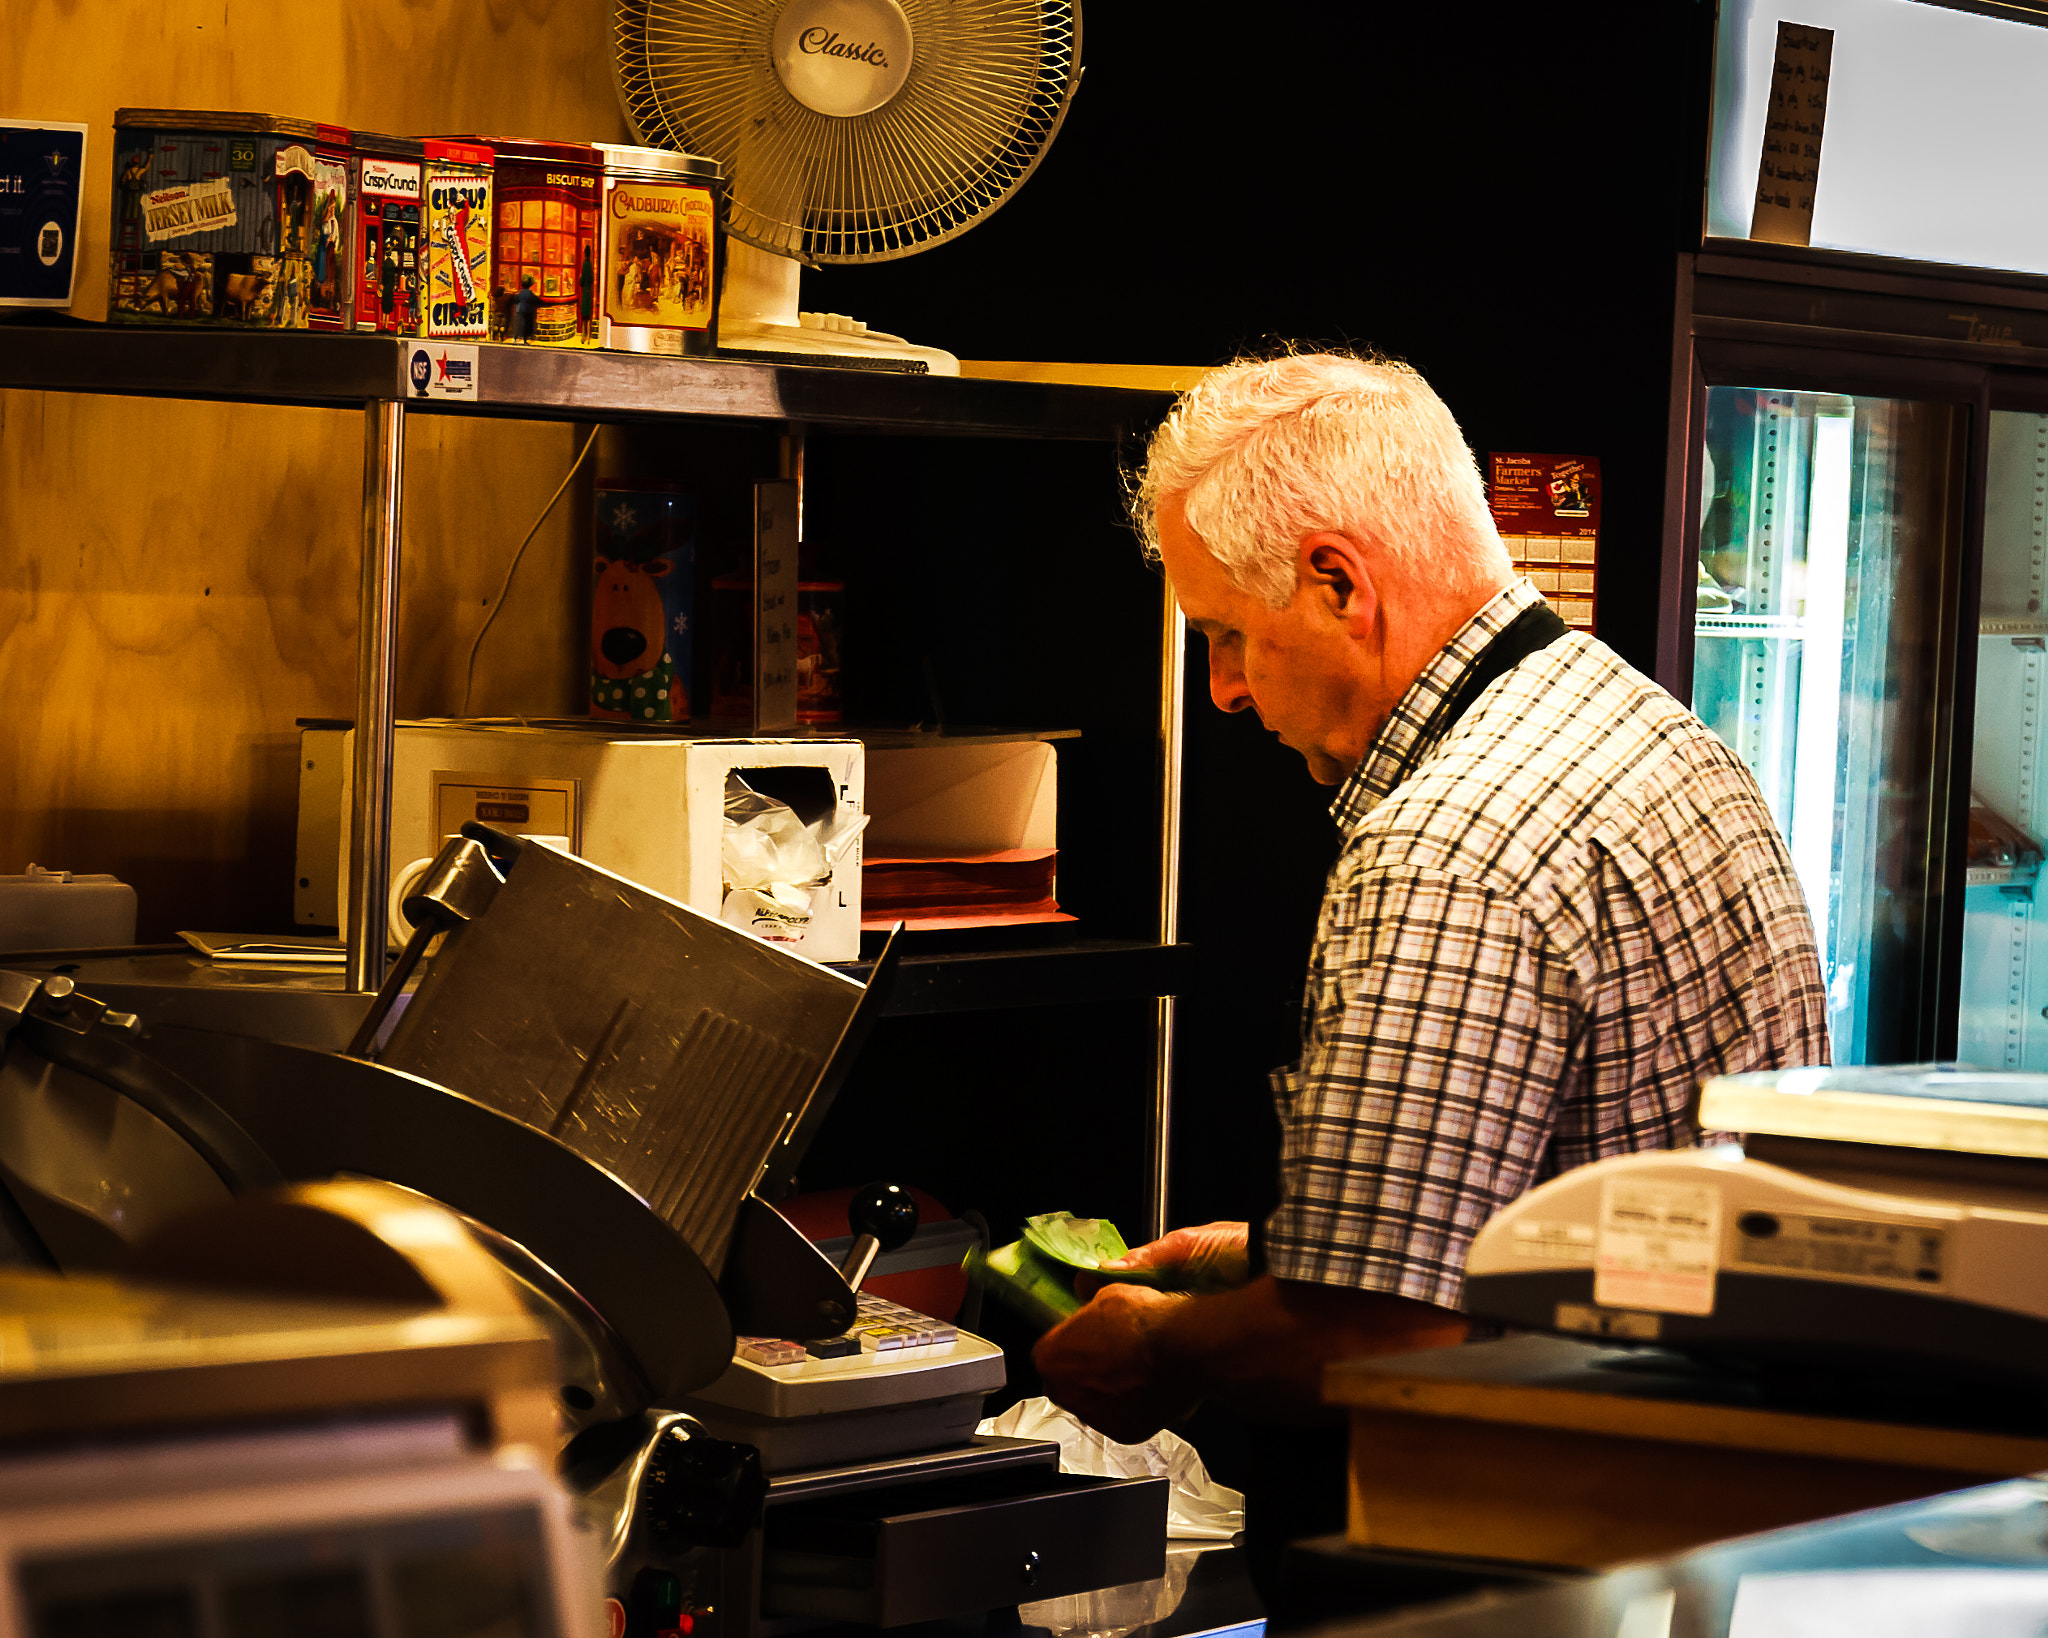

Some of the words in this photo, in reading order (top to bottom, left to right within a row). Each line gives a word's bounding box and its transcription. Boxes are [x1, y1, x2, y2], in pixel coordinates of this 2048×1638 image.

[232, 150, 254, 161] 30
[546, 173, 580, 186] BISCUIT
[580, 177, 595, 188] SHOP
[148, 200, 194, 232] JERSEY
[195, 191, 234, 222] MILK
[1495, 476, 1530, 486] Market
[1579, 528, 1596, 536] 2014
